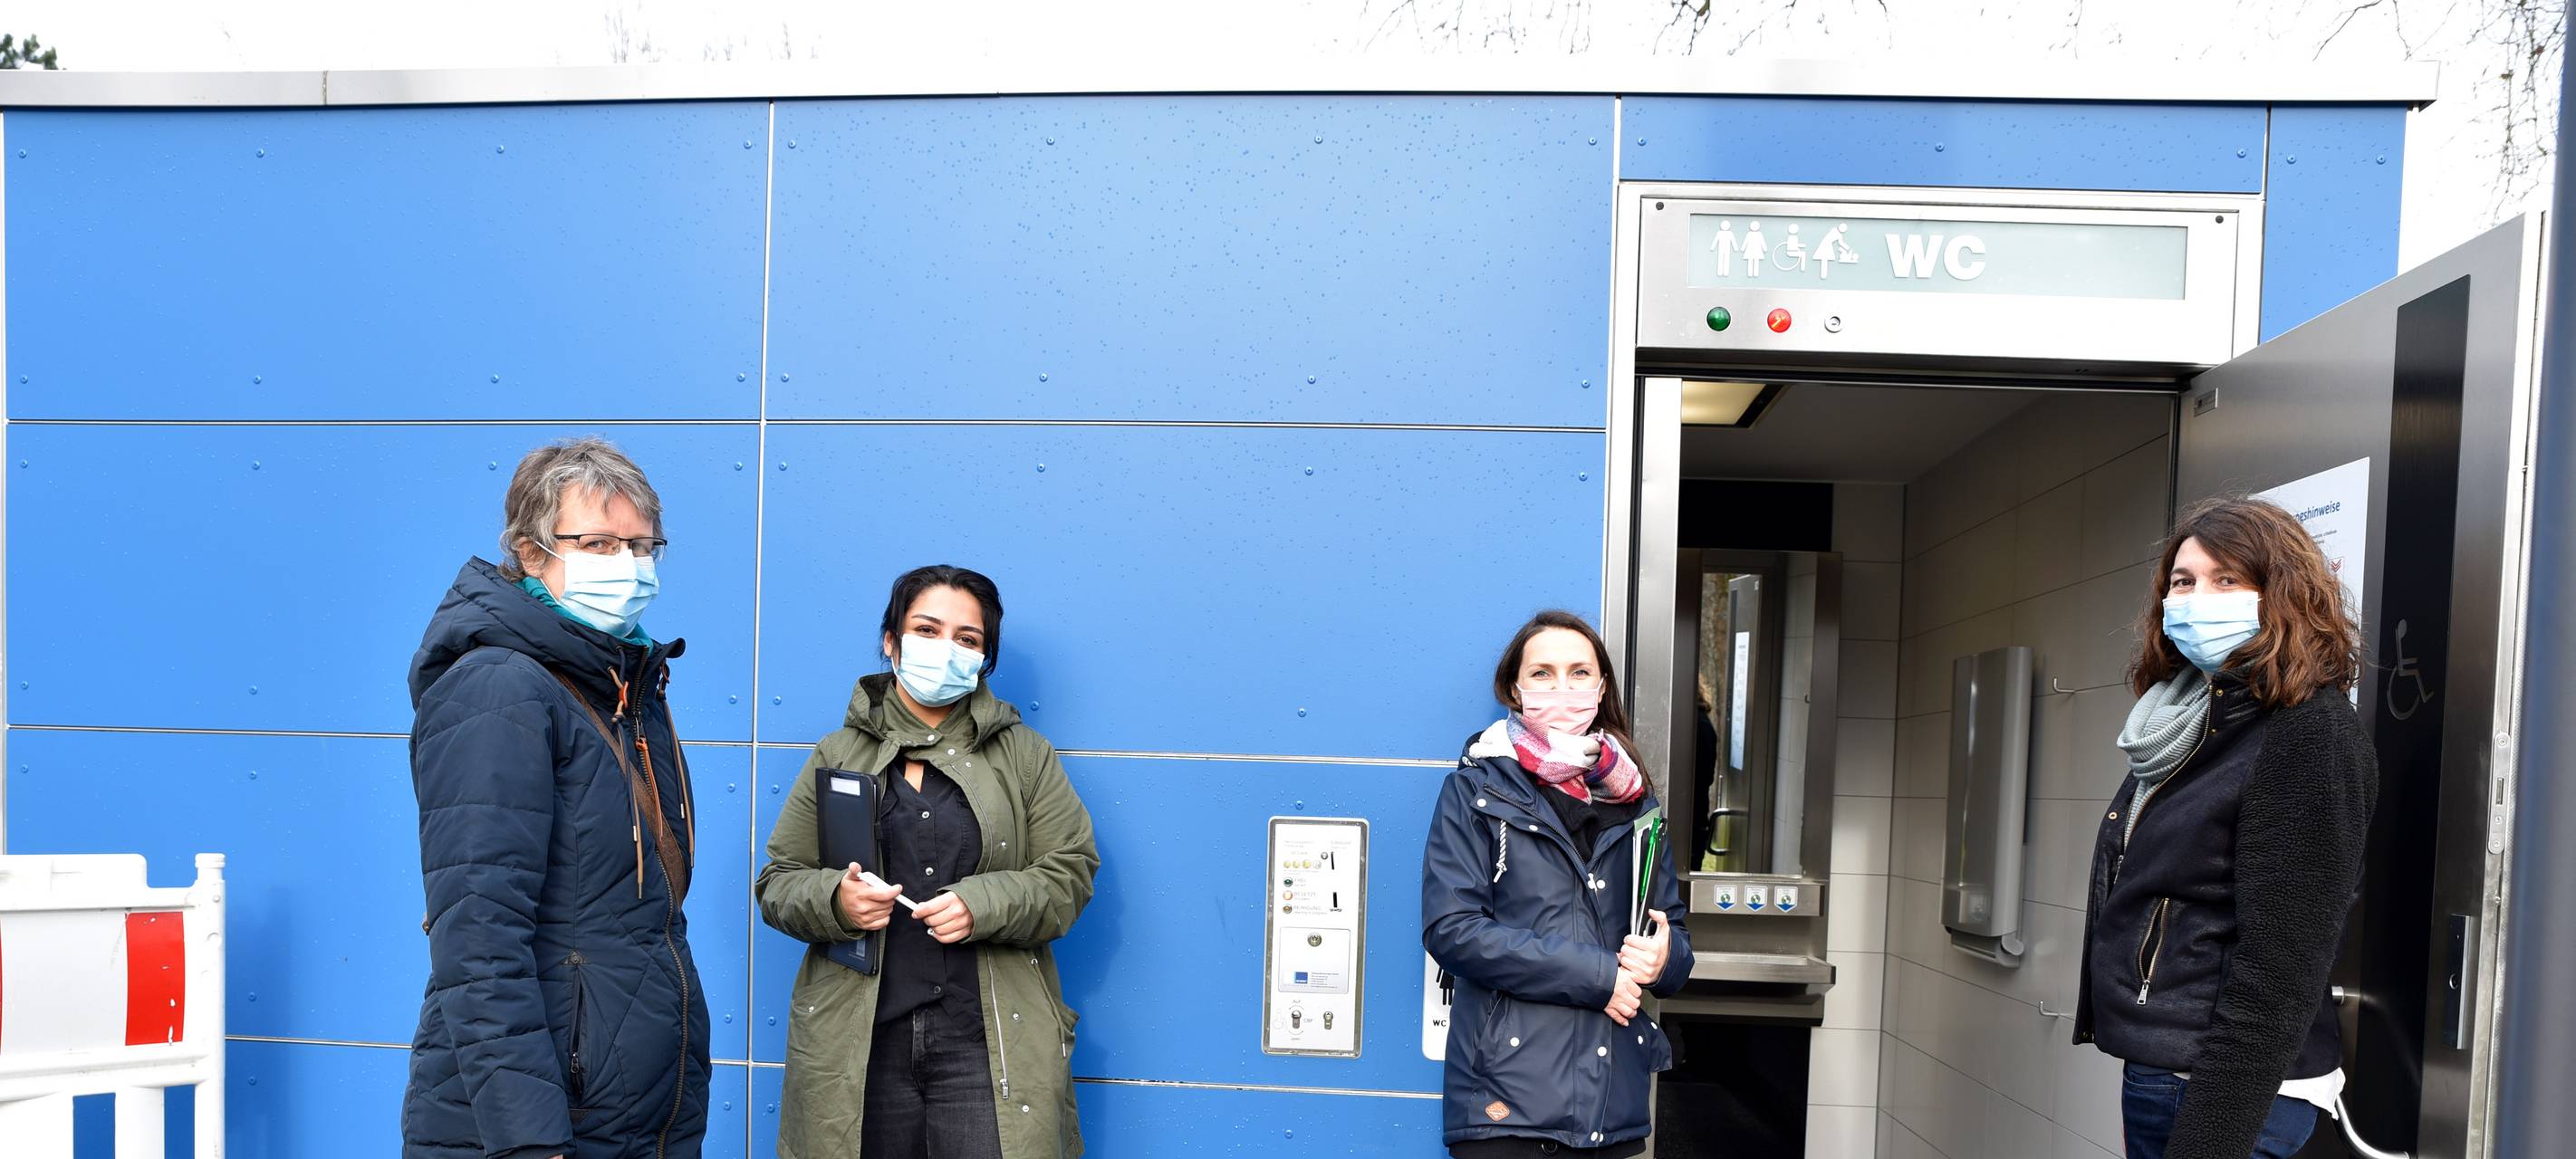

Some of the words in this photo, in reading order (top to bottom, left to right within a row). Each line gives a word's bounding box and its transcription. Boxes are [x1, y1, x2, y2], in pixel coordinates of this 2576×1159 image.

[1884, 233, 1986, 281] WC
[2293, 500, 2341, 524] ngshinweise
[1432, 1019, 1447, 1028] WC
